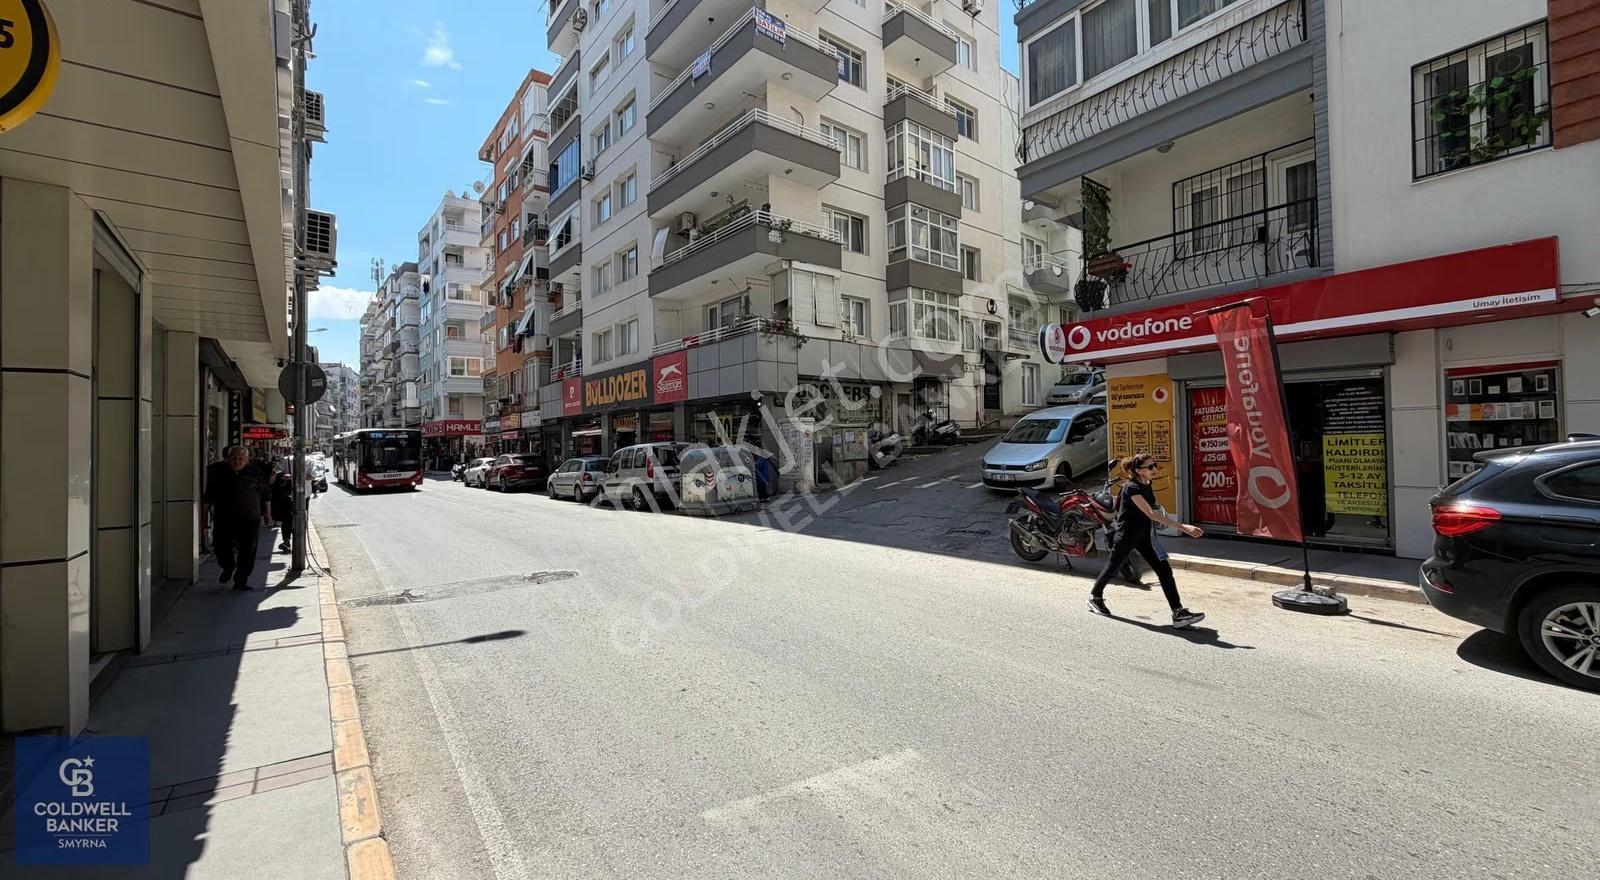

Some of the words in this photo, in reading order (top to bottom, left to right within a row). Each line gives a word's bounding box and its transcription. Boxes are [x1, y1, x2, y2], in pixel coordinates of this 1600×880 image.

[1473, 300, 1500, 308] Umay
[1096, 315, 1192, 343] vodafone
[585, 368, 648, 407] BULLDOZER
[446, 423, 481, 432] HAMLE
[613, 416, 636, 430] BULLDOZE
[1366, 472, 1381, 480] AY
